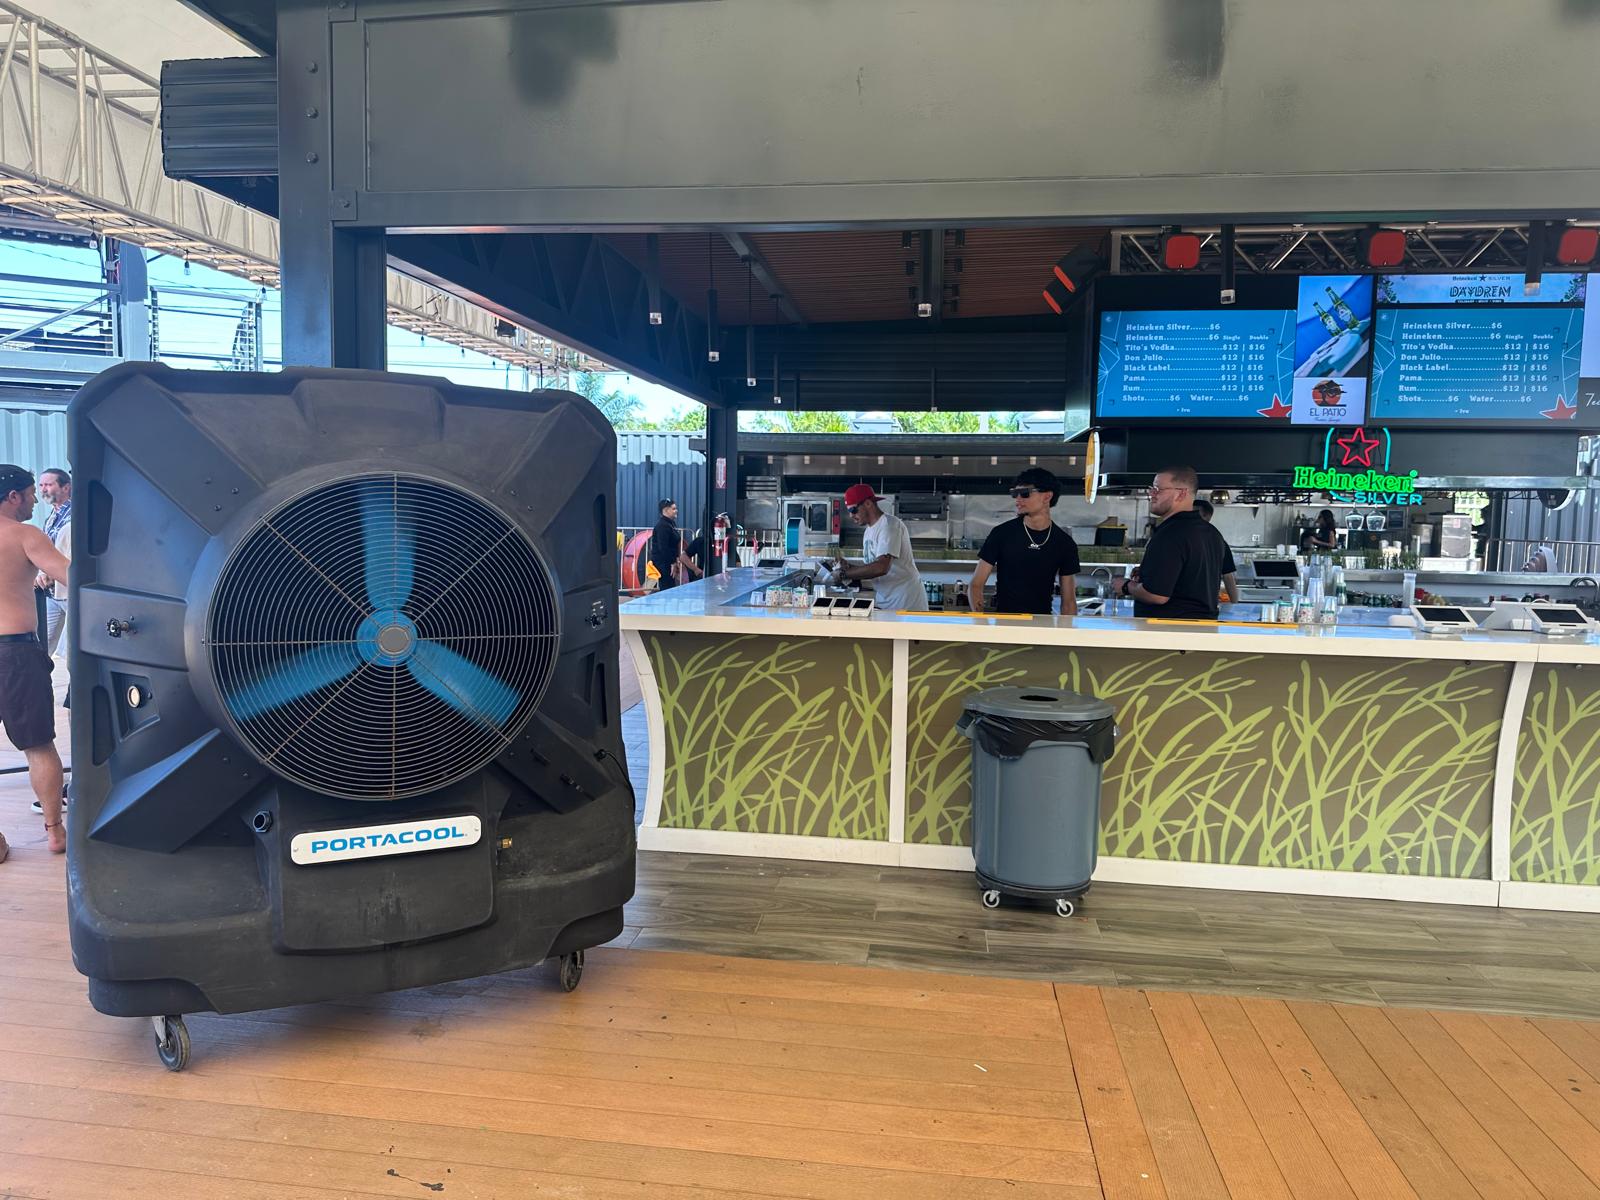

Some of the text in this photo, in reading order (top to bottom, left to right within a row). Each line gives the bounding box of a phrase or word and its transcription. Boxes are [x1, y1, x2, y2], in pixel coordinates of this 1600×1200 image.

[1420, 353, 1441, 361] Julio
[1310, 408, 1347, 417] EL PATIO
[1293, 466, 1416, 493] Heineken
[1354, 492, 1423, 505] SILVER
[311, 826, 465, 854] PORTACOOL
